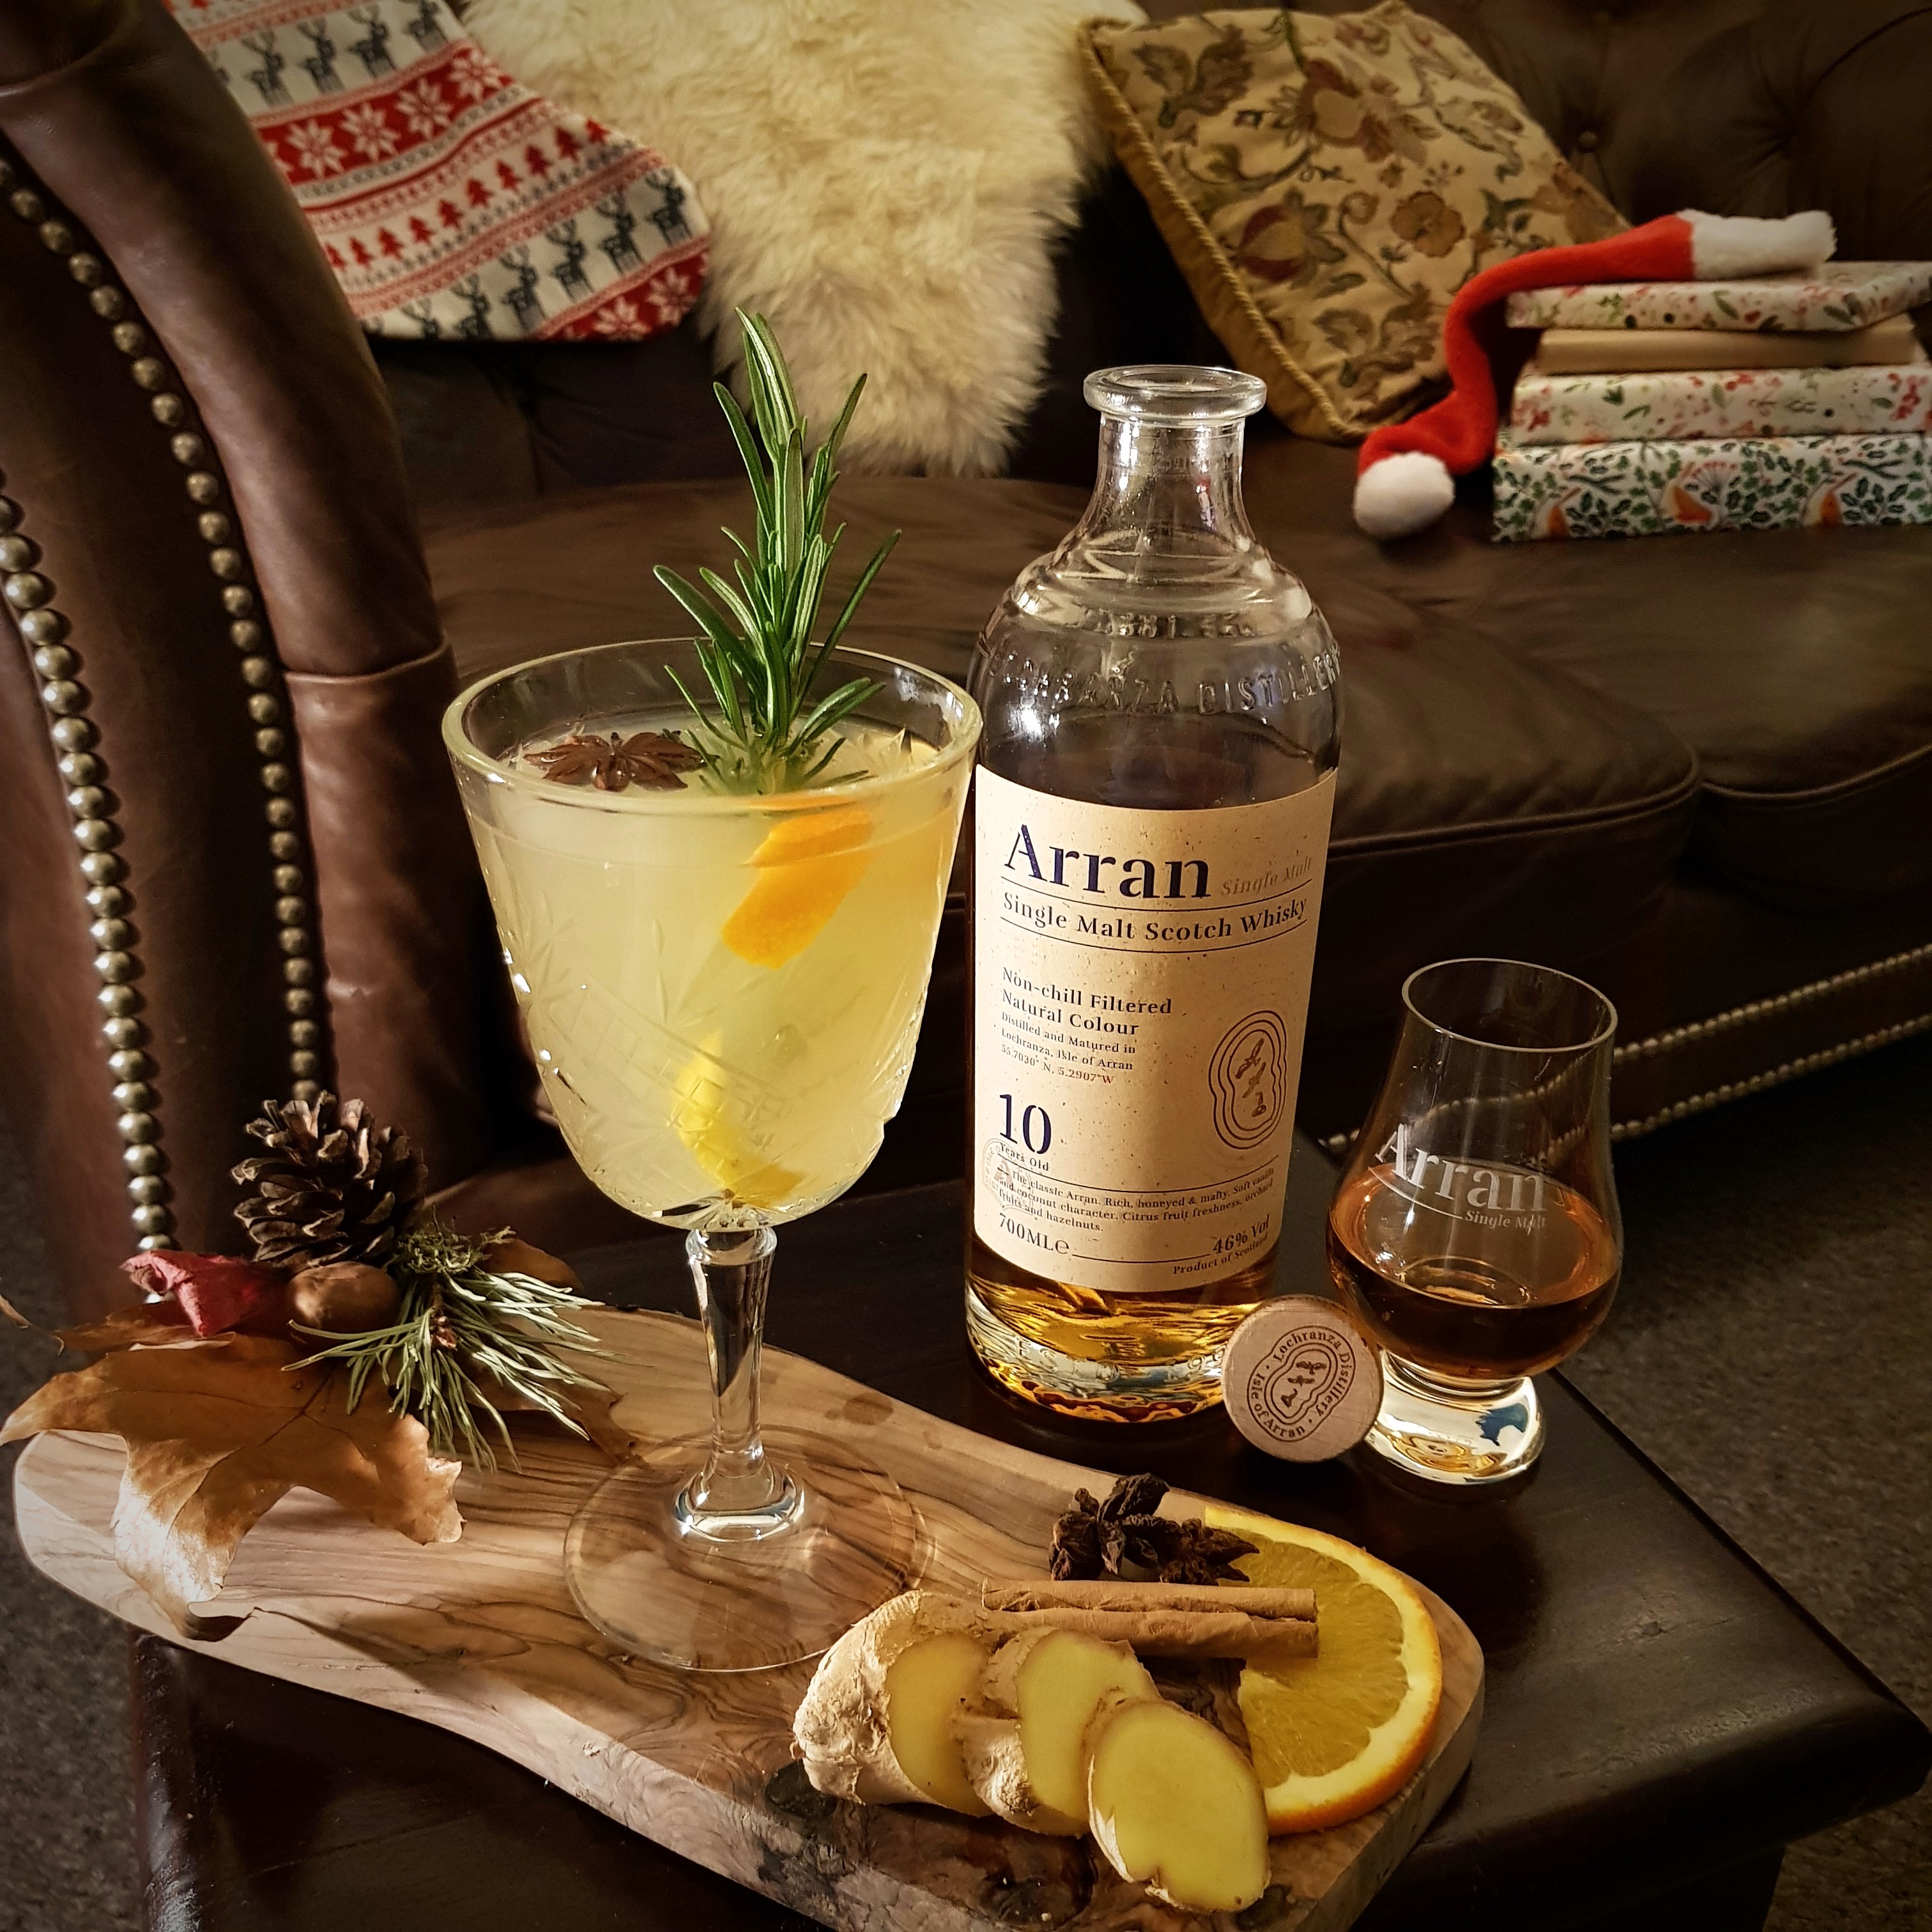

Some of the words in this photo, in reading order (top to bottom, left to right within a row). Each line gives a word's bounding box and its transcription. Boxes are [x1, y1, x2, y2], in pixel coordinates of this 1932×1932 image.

[1004, 824, 1211, 899] Arran
[1220, 871, 1278, 895] Single
[1004, 892, 1067, 928] Single
[1077, 914, 1136, 939] Malt
[1146, 917, 1232, 942] Scotch
[1240, 898, 1307, 933] Whisky
[1002, 967, 1082, 1006] Non-chill
[1091, 994, 1172, 1014] Filtered
[1002, 988, 1062, 1023] Natural
[1070, 1013, 1139, 1035] Colour
[1002, 1011, 1041, 1036] Distilled
[1045, 1030, 1064, 1043] and
[1069, 1036, 1119, 1053] Matured
[1124, 1044, 1135, 1054] in
[1002, 1027, 1054, 1057] Lochranza,
[1058, 1050, 1078, 1062] Isle
[1082, 1056, 1095, 1065] of
[1098, 1059, 1133, 1070] Arran
[999, 1094, 1052, 1154] 10
[1000, 1142, 1025, 1162] Years
[1030, 1158, 1049, 1171] Old
[1375, 1123, 1546, 1211] Arran
[1012, 1170, 1027, 1184] The
[1031, 1180, 1064, 1197] classic
[1138, 1197, 1185, 1210] honeyed
[1188, 1197, 1196, 1205] &
[1233, 1181, 1250, 1195] Soft
[1017, 1187, 1057, 1209] coconut
[1123, 1211, 1159, 1221] Citrus
[1163, 1211, 1188, 1220] fruit
[1024, 1206, 1043, 1218] and
[1046, 1209, 1103, 1232] hazelnuts.
[1213, 1229, 1248, 1254] 46%
[1251, 1213, 1269, 1238] Vol
[1465, 1210, 1511, 1230] Single
[1173, 1259, 1218, 1275] Product
[1221, 1252, 1232, 1264] of
[1234, 1231, 1268, 1259] Scotland
[1251, 1372, 1266, 1400] Isle
[1273, 1331, 1342, 1362] Lochranza
[1315, 1352, 1353, 1417] Distillery
[1254, 1403, 1268, 1418] of
[1264, 1418, 1307, 1438] Arran
